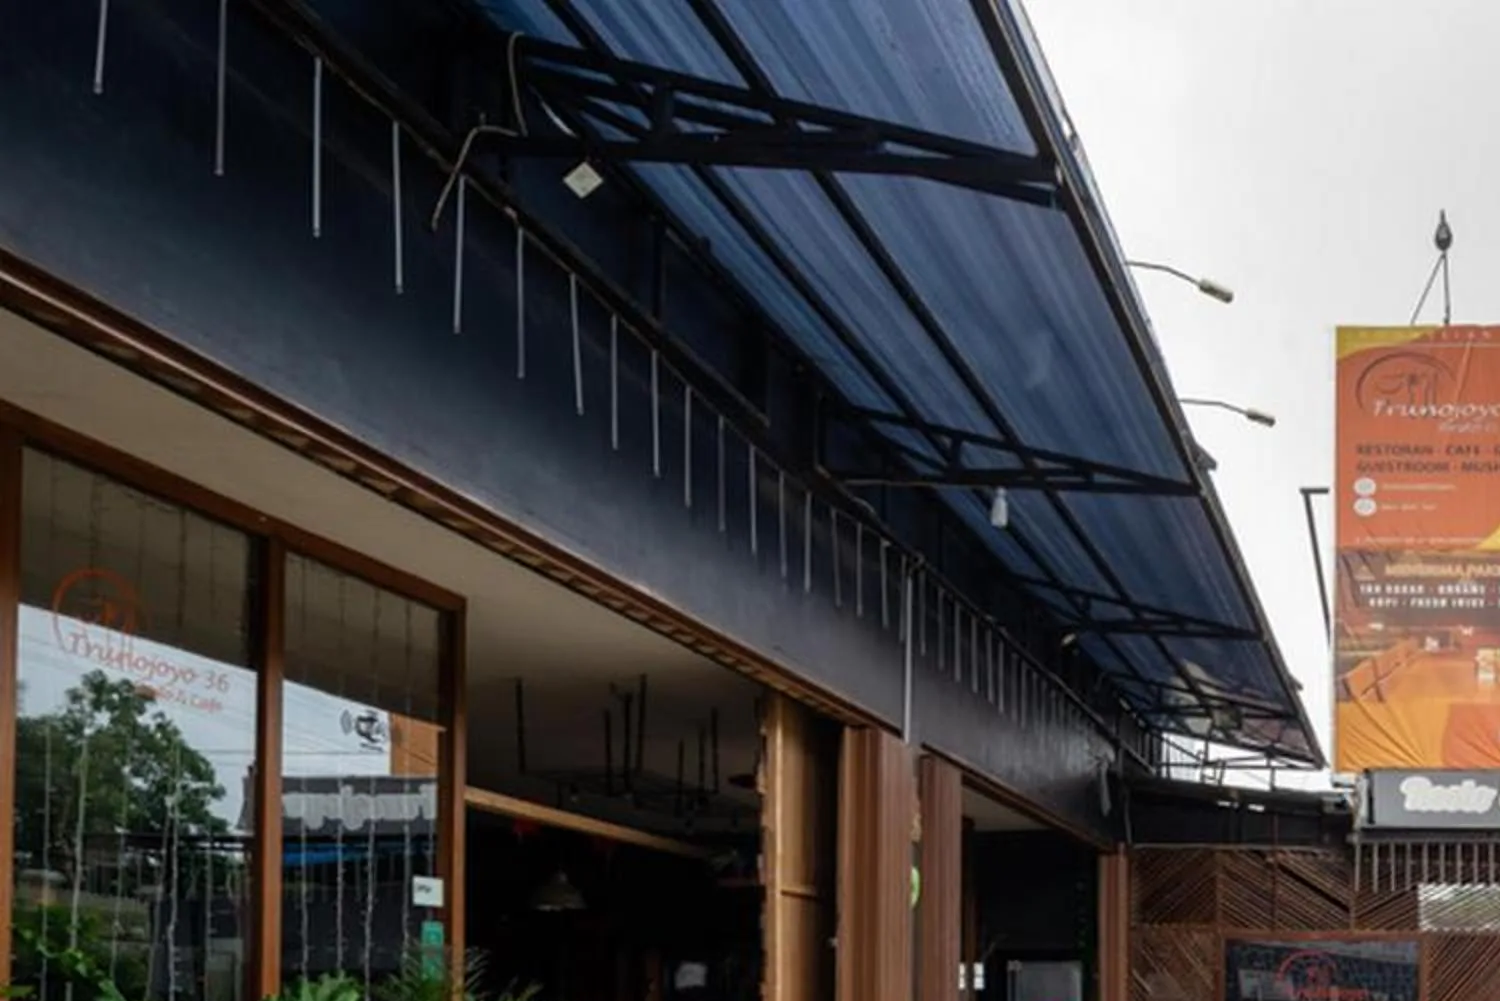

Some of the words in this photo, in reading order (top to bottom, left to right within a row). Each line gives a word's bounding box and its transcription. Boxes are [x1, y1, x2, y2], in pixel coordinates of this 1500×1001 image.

[1356, 444, 1435, 457] RESTORAN
[1446, 444, 1481, 457] CAFE
[1356, 460, 1449, 474] GUESTROOM
[66, 630, 201, 687] Trunojoyo
[204, 670, 231, 694] 36
